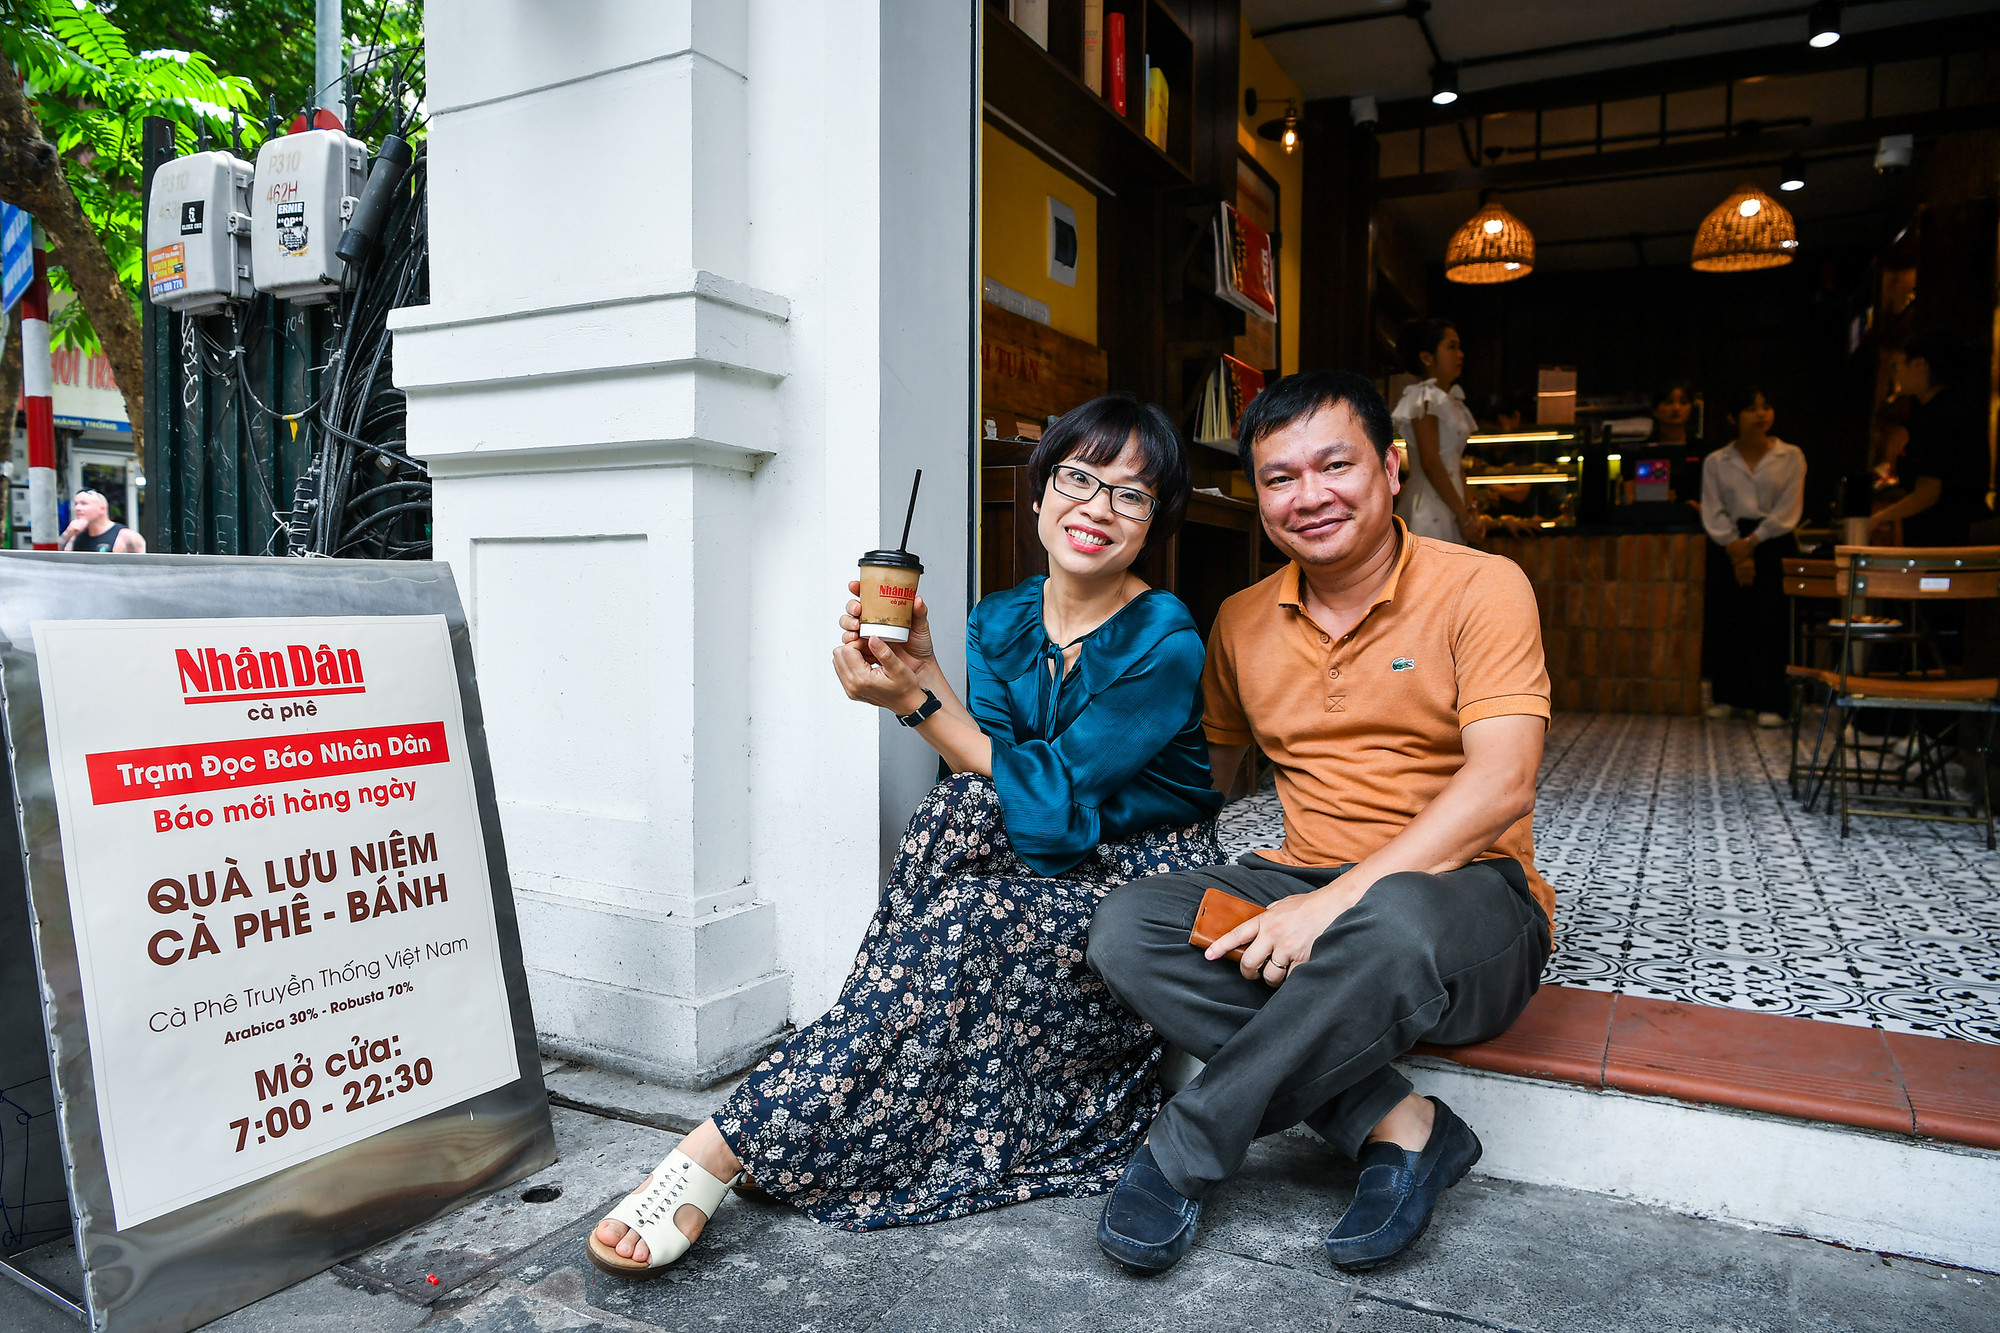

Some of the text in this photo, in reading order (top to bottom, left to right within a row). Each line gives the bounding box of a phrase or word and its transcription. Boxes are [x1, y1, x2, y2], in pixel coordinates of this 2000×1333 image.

[269, 150, 301, 175] P310
[266, 180, 298, 204] 462H
[277, 202, 304, 215] ERNIE
[174, 643, 365, 694] Nhân Dân
[247, 700, 319, 722] cà phê
[116, 733, 432, 790] Trạm Đọc Báo Nhân Dân
[153, 776, 418, 834] Báo mới hàng ngày
[147, 829, 439, 915] QUÀ LƯU NIỆM
[147, 872, 450, 967] CÀ PHÊ - BÁNH
[148, 937, 470, 1033] Cà Phê Truyền Thống Việt Nam
[223, 1018, 286, 1045] Arabica
[288, 1007, 320, 1027] 30%
[329, 990, 386, 1015] Robusta
[386, 980, 415, 999] 70%
[254, 1034, 403, 1103] Mở cửa:
[229, 1057, 435, 1153] 7:00 - 22:30
